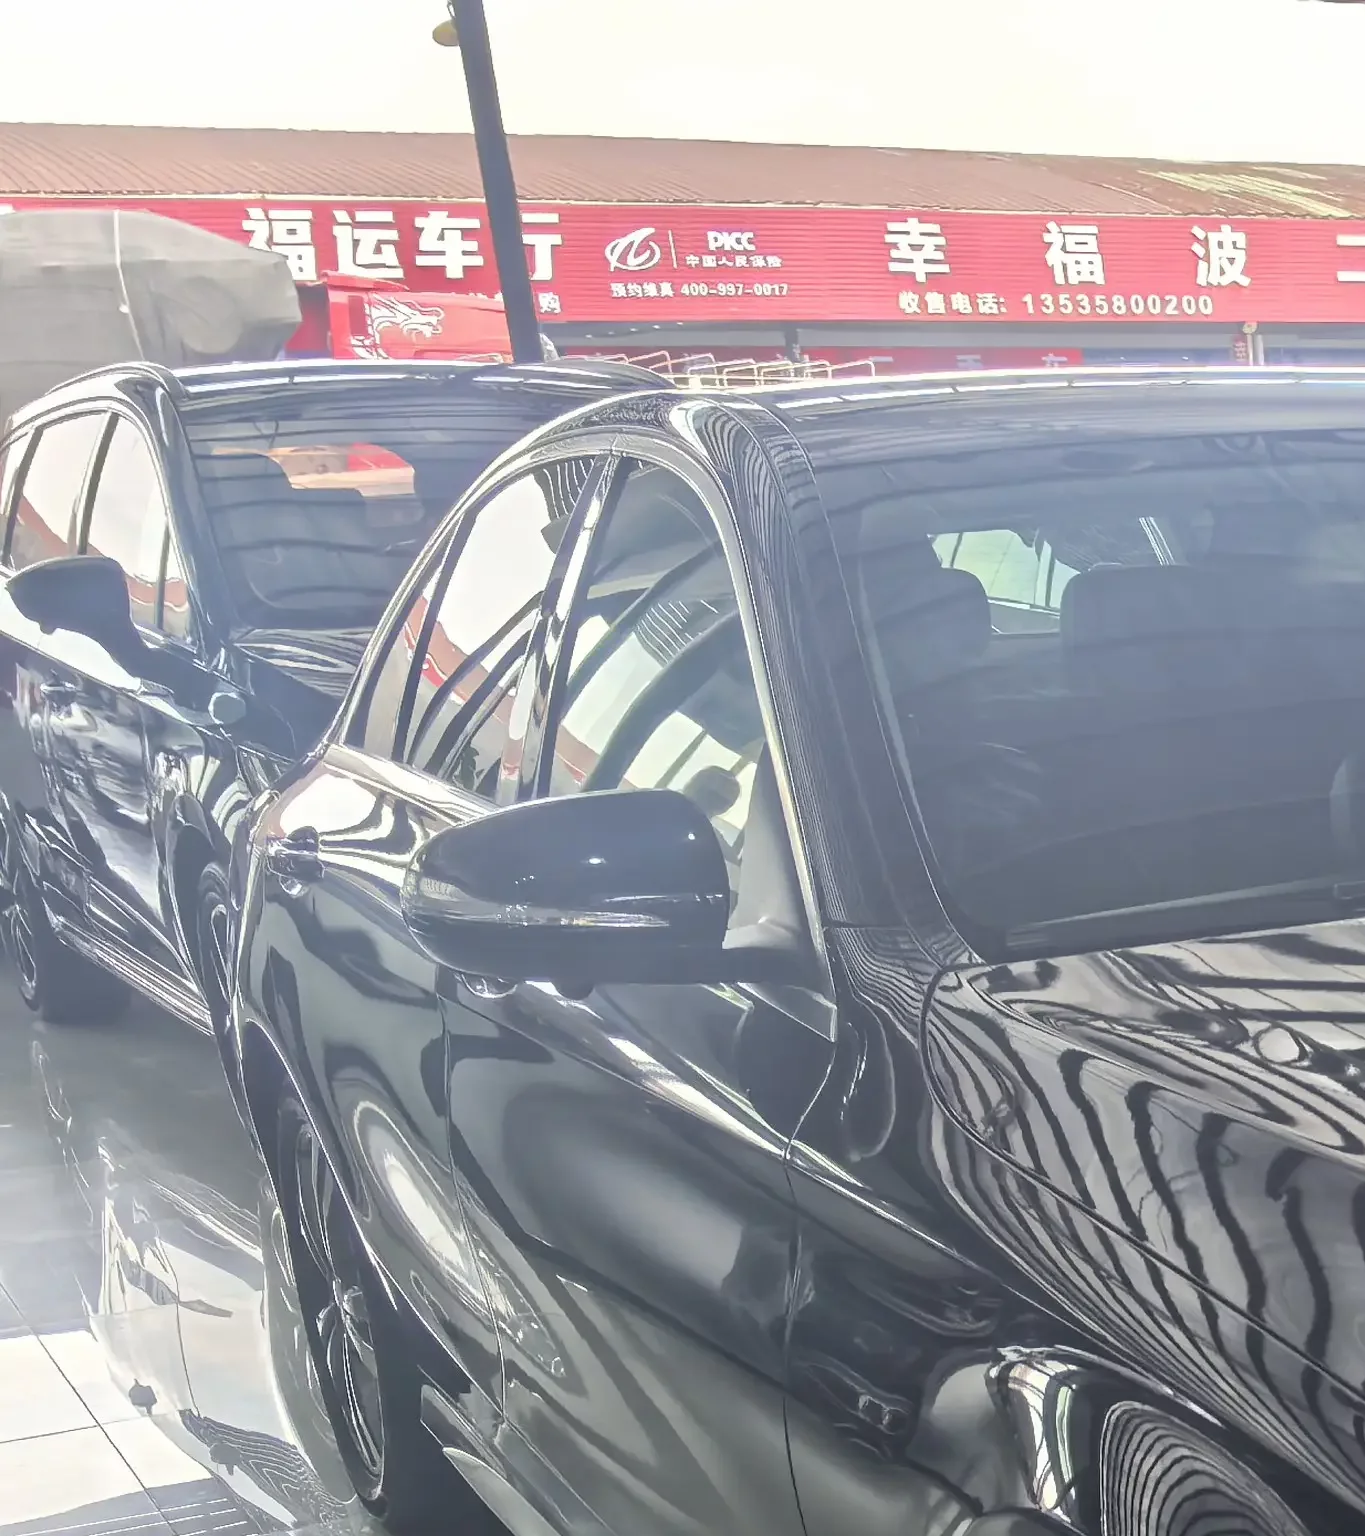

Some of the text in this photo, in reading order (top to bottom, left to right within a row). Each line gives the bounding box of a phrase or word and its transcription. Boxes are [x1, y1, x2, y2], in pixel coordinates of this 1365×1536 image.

[242, 207, 563, 281] 福运车行
[706, 231, 756, 251] PICC
[685, 254, 783, 268] 中国人民保险
[1022, 293, 1214, 316] 13535800200
